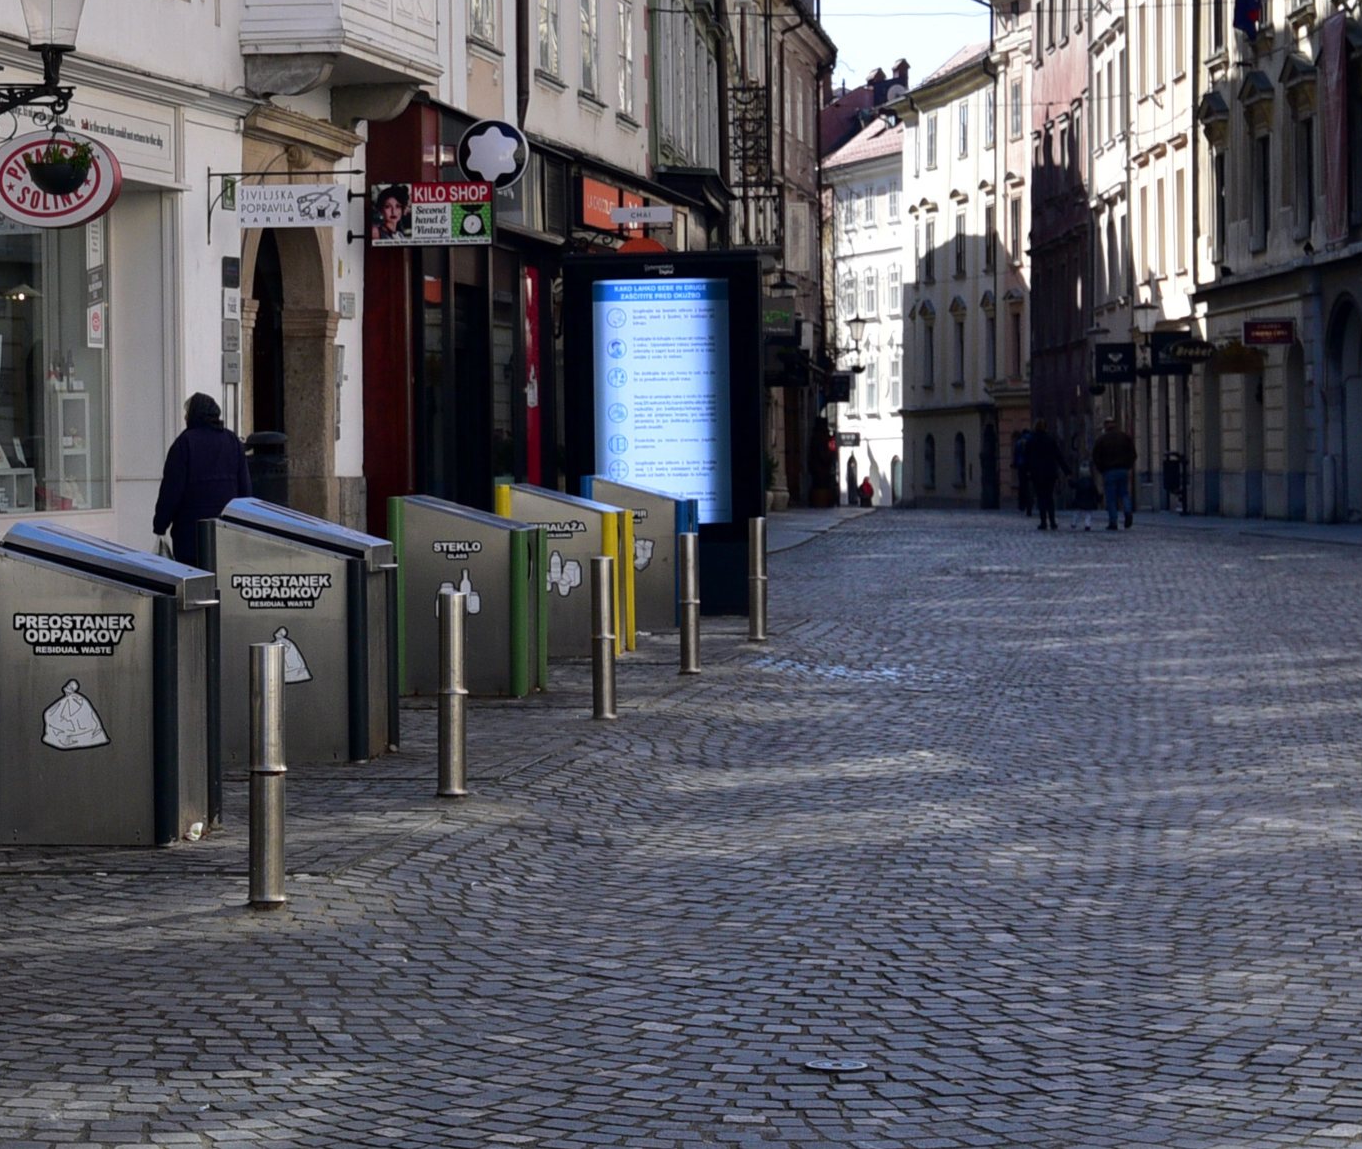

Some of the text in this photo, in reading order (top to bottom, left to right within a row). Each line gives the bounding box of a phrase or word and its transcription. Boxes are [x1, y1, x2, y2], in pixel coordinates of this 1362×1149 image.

[414, 186, 446, 202] KILO
[449, 185, 488, 202] SHOP
[241, 202, 294, 214] POPRAVILA
[415, 205, 446, 215] Second
[415, 215, 447, 225] hand &
[414, 224, 449, 237] Vintage
[1102, 364, 1128, 373] ROXY
[433, 542, 481, 552] STEKLO
[232, 575, 330, 587] PREOSTANEK
[241, 587, 321, 599] ODPADKOV
[15, 615, 133, 629] PREOSTANEK
[25, 629, 122, 643] ODPADKOV
[35, 646, 112, 654] RESIDUAL WASTE
